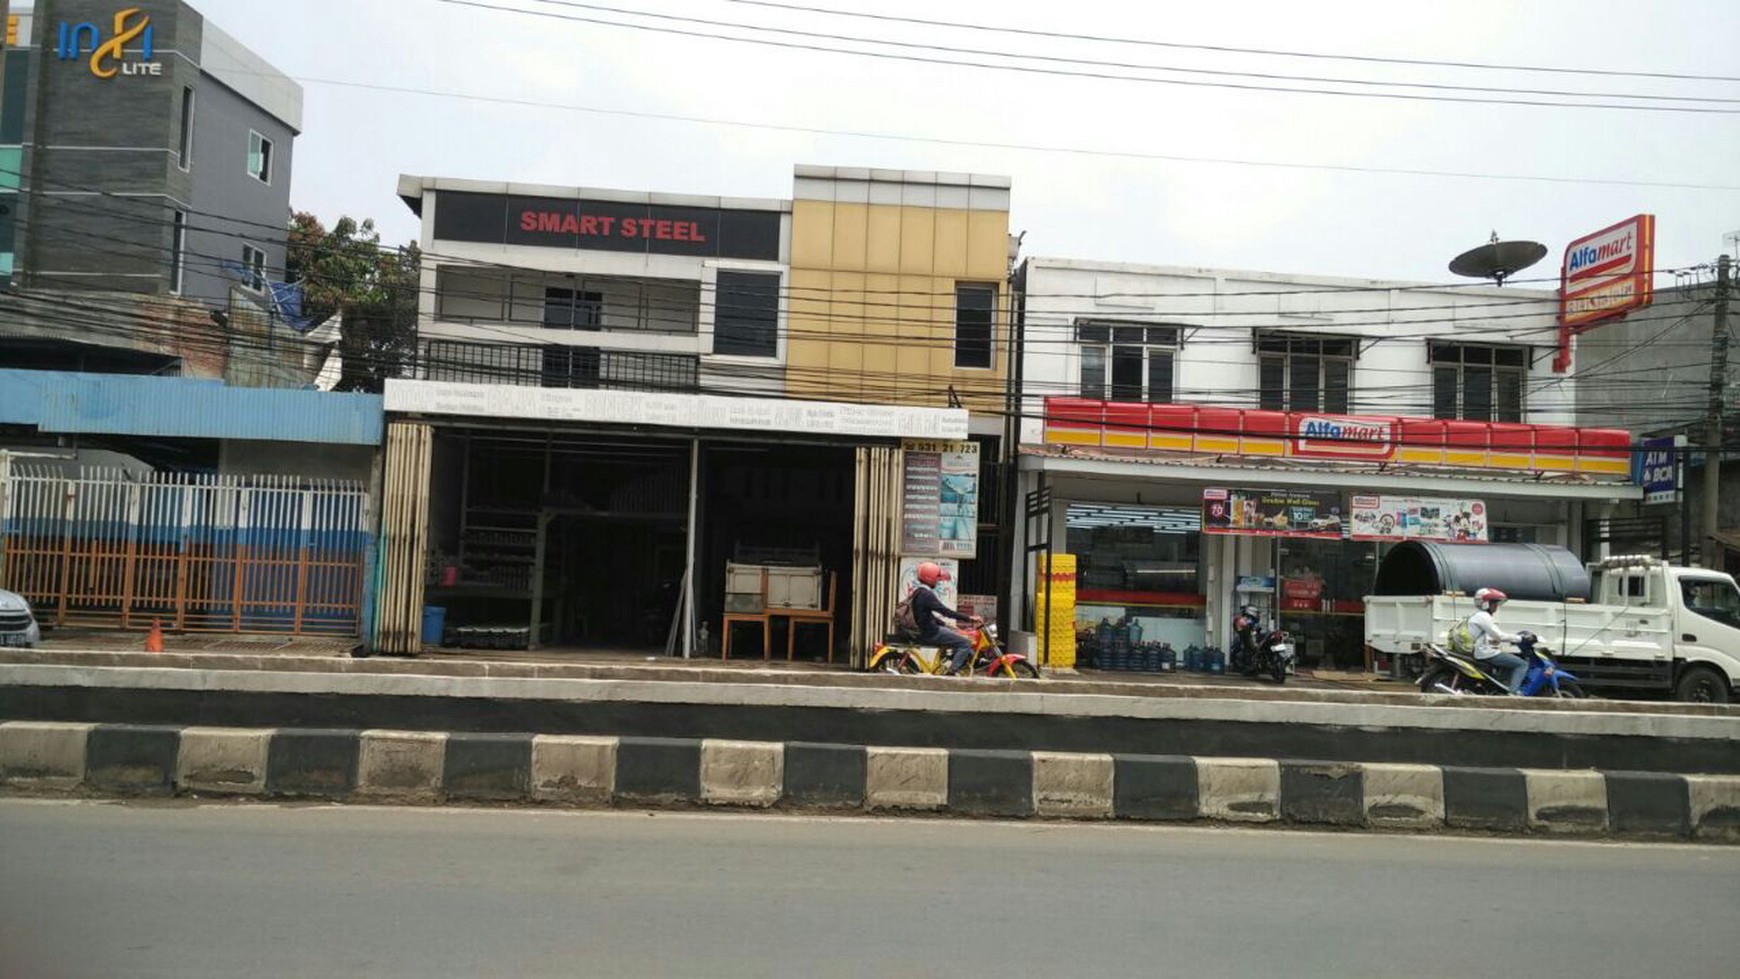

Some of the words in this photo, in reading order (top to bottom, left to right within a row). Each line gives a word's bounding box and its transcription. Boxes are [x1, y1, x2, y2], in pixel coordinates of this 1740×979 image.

[121, 62, 162, 76] LITE
[520, 211, 616, 236] SMART
[620, 217, 706, 242] STEEL
[1569, 231, 1633, 271] Alfamart
[1305, 421, 1384, 440] Alfamart
[942, 444, 954, 453] 21
[960, 444, 978, 454] 723
[1645, 451, 1668, 466] ATM
[1653, 465, 1673, 482] BCA
